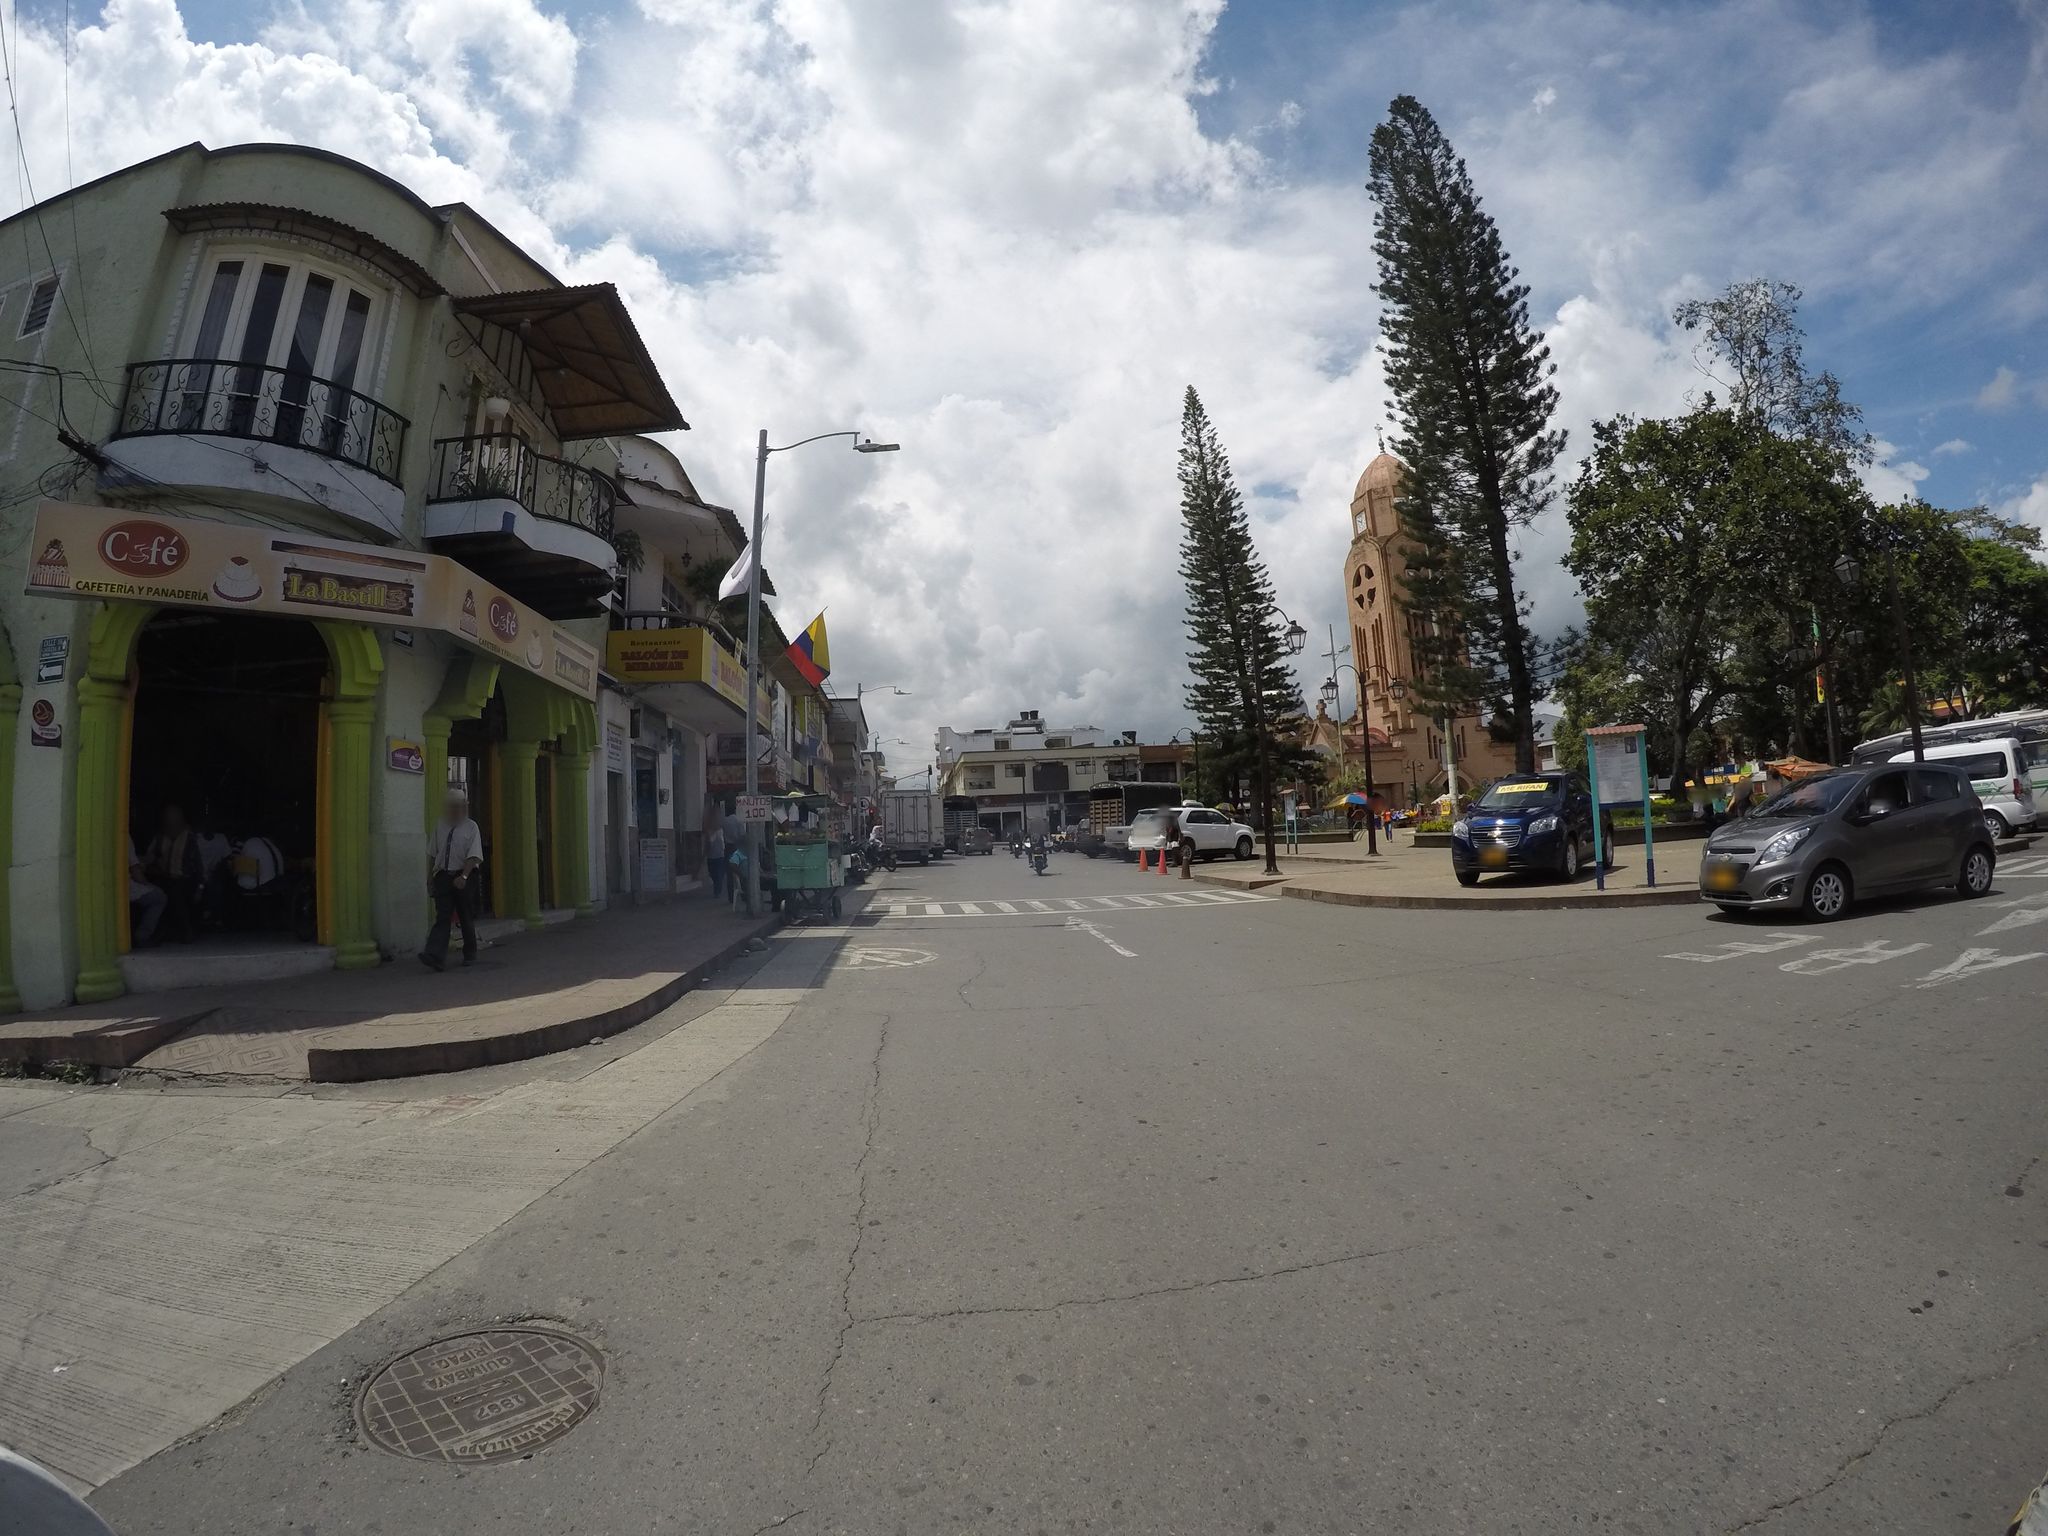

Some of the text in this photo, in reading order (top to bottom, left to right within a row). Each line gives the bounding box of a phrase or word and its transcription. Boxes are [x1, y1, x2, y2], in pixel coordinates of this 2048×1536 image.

[75, 580, 209, 602] CAFETERÍA Y PANADERÍA
[290, 574, 318, 599] La
[736, 797, 771, 807] MINUTOS
[745, 808, 766, 818] 100
[423, 1355, 513, 1391] QUIMBAYA
[455, 1404, 575, 1456] ALCANTARILLADO
